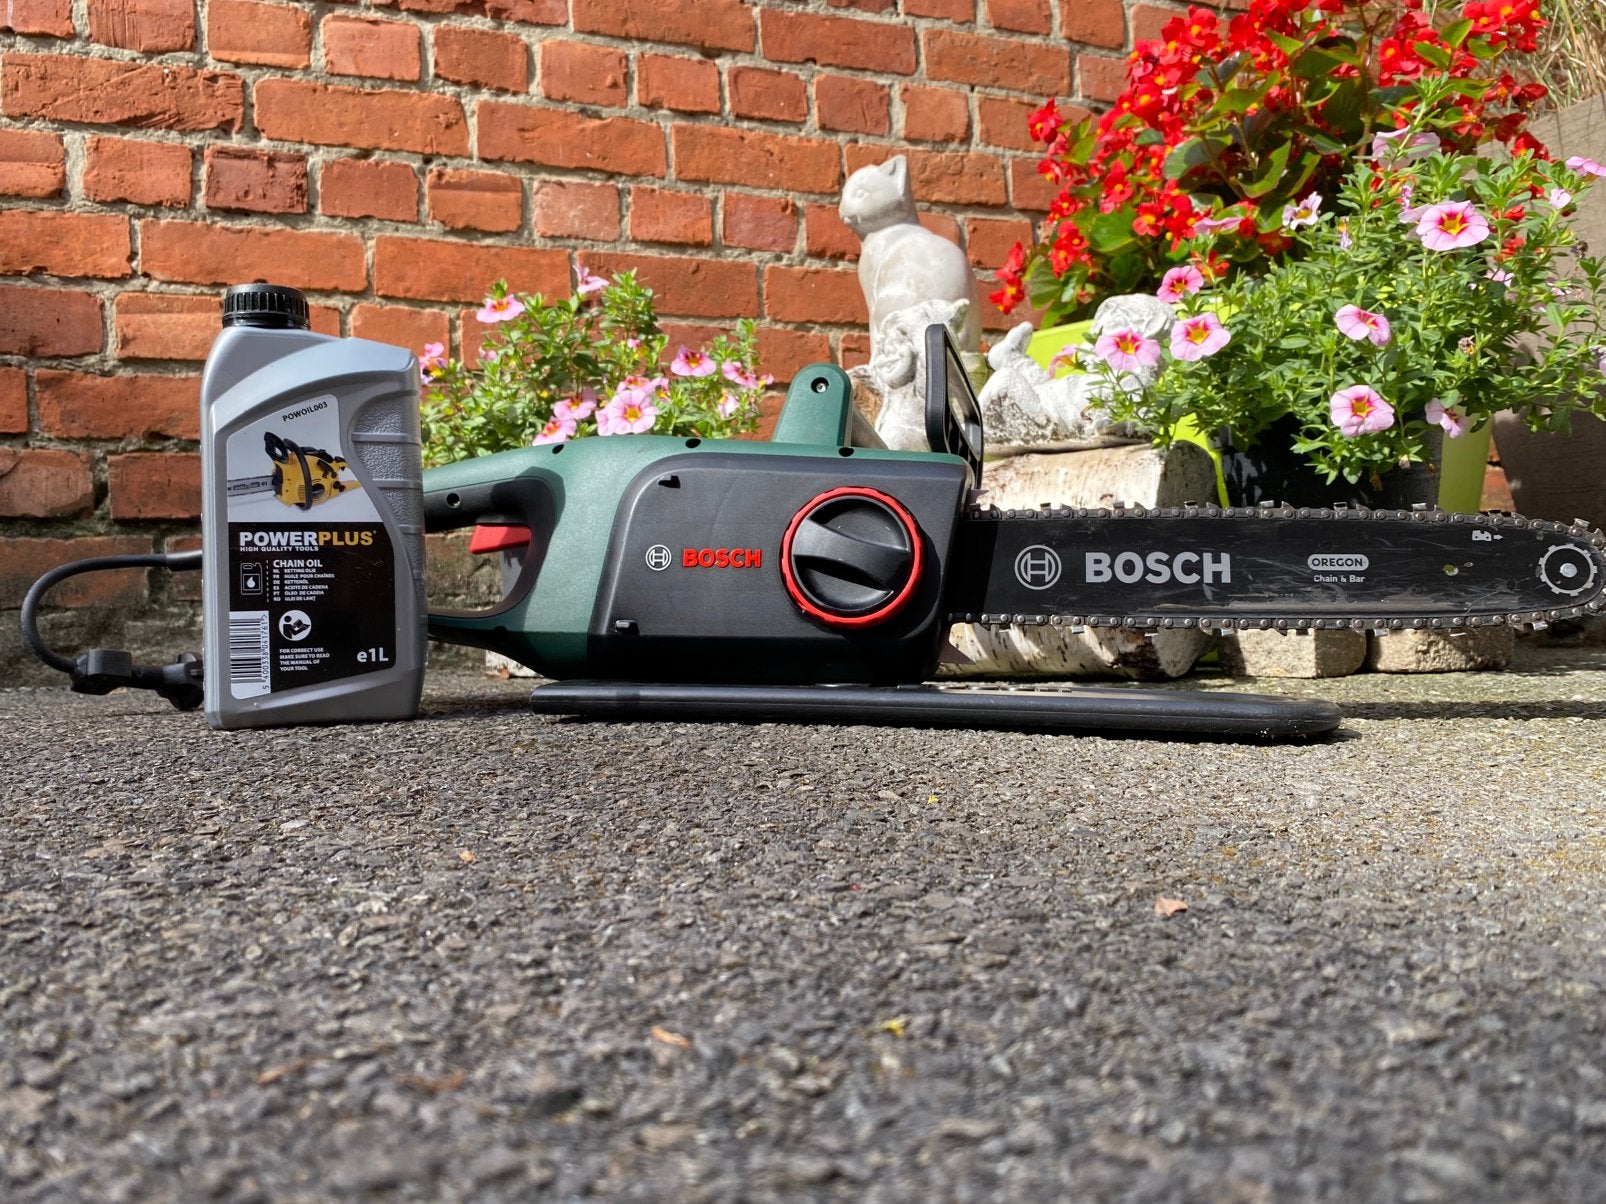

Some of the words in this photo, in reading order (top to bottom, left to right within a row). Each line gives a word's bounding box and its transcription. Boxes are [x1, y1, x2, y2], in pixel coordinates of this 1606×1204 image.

[282, 401, 329, 422] POWOIL003
[239, 531, 374, 546] POWERPLUS
[273, 559, 305, 568] CHAIN
[306, 559, 323, 568] OIL
[682, 548, 762, 568] BOSCH
[1311, 557, 1365, 568] OREGON
[1085, 551, 1232, 584] BOSCH
[1313, 575, 1338, 583] Chain
[1349, 574, 1366, 583] Bar
[261, 622, 269, 649] 041761
